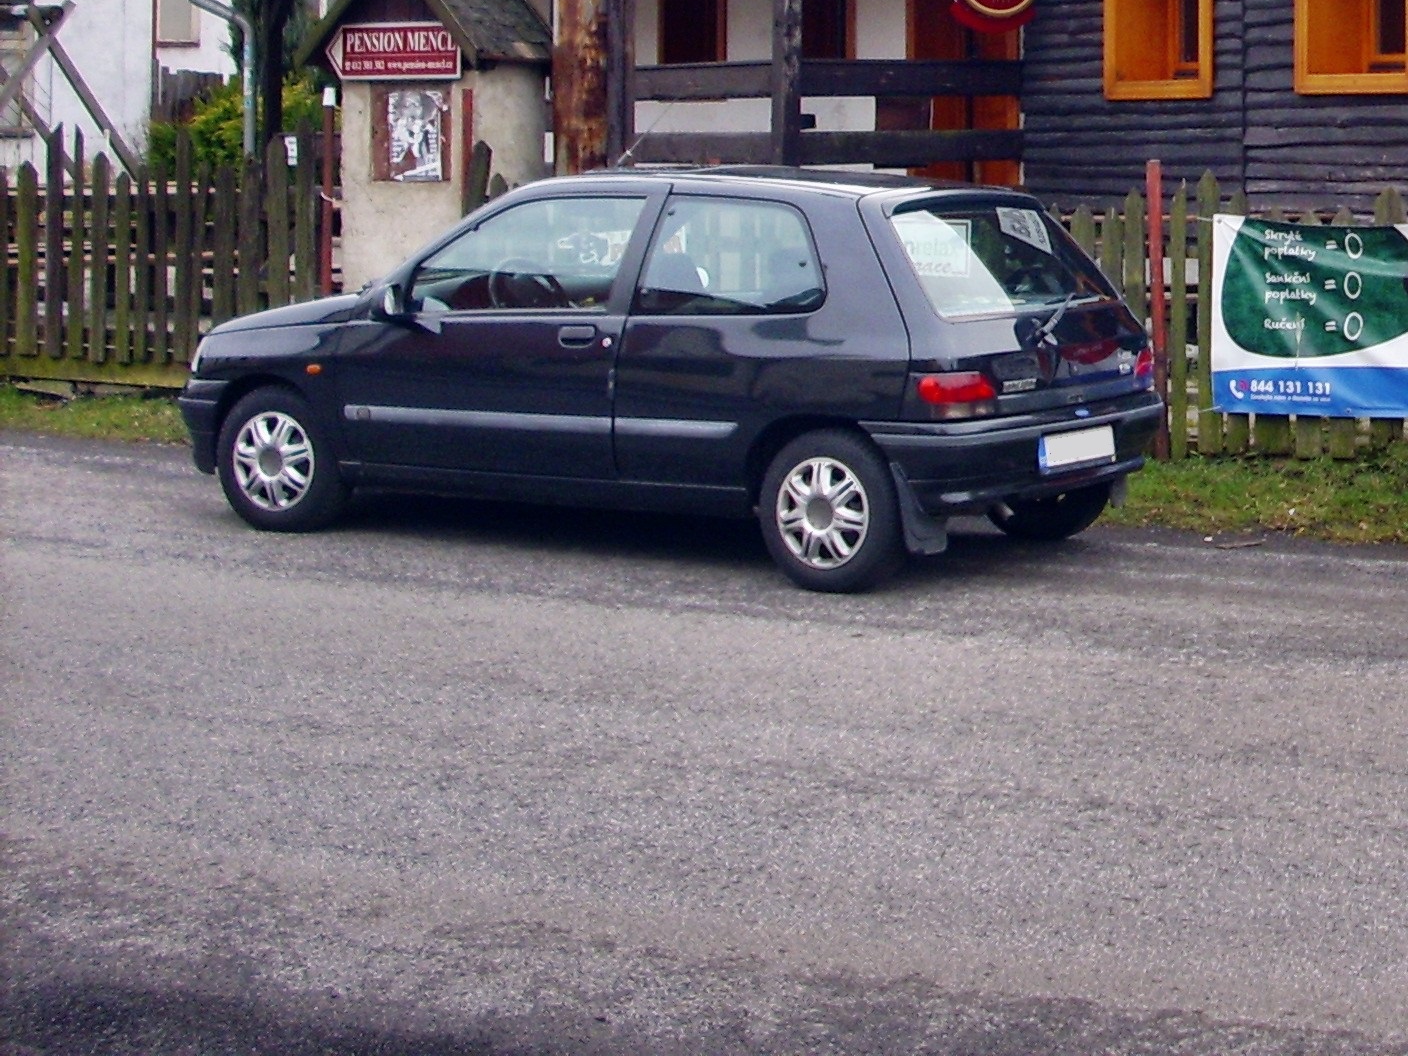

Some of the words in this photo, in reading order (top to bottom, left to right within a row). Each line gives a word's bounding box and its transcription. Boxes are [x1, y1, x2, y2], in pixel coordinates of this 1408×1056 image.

[346, 31, 404, 53] PENSION
[406, 31, 456, 52] MENCL
[1264, 245, 1316, 261] poplatky
[1265, 289, 1316, 305] poplatky
[1250, 379, 1274, 393] 844
[1278, 380, 1302, 394] 131
[1307, 381, 1331, 395] 131
